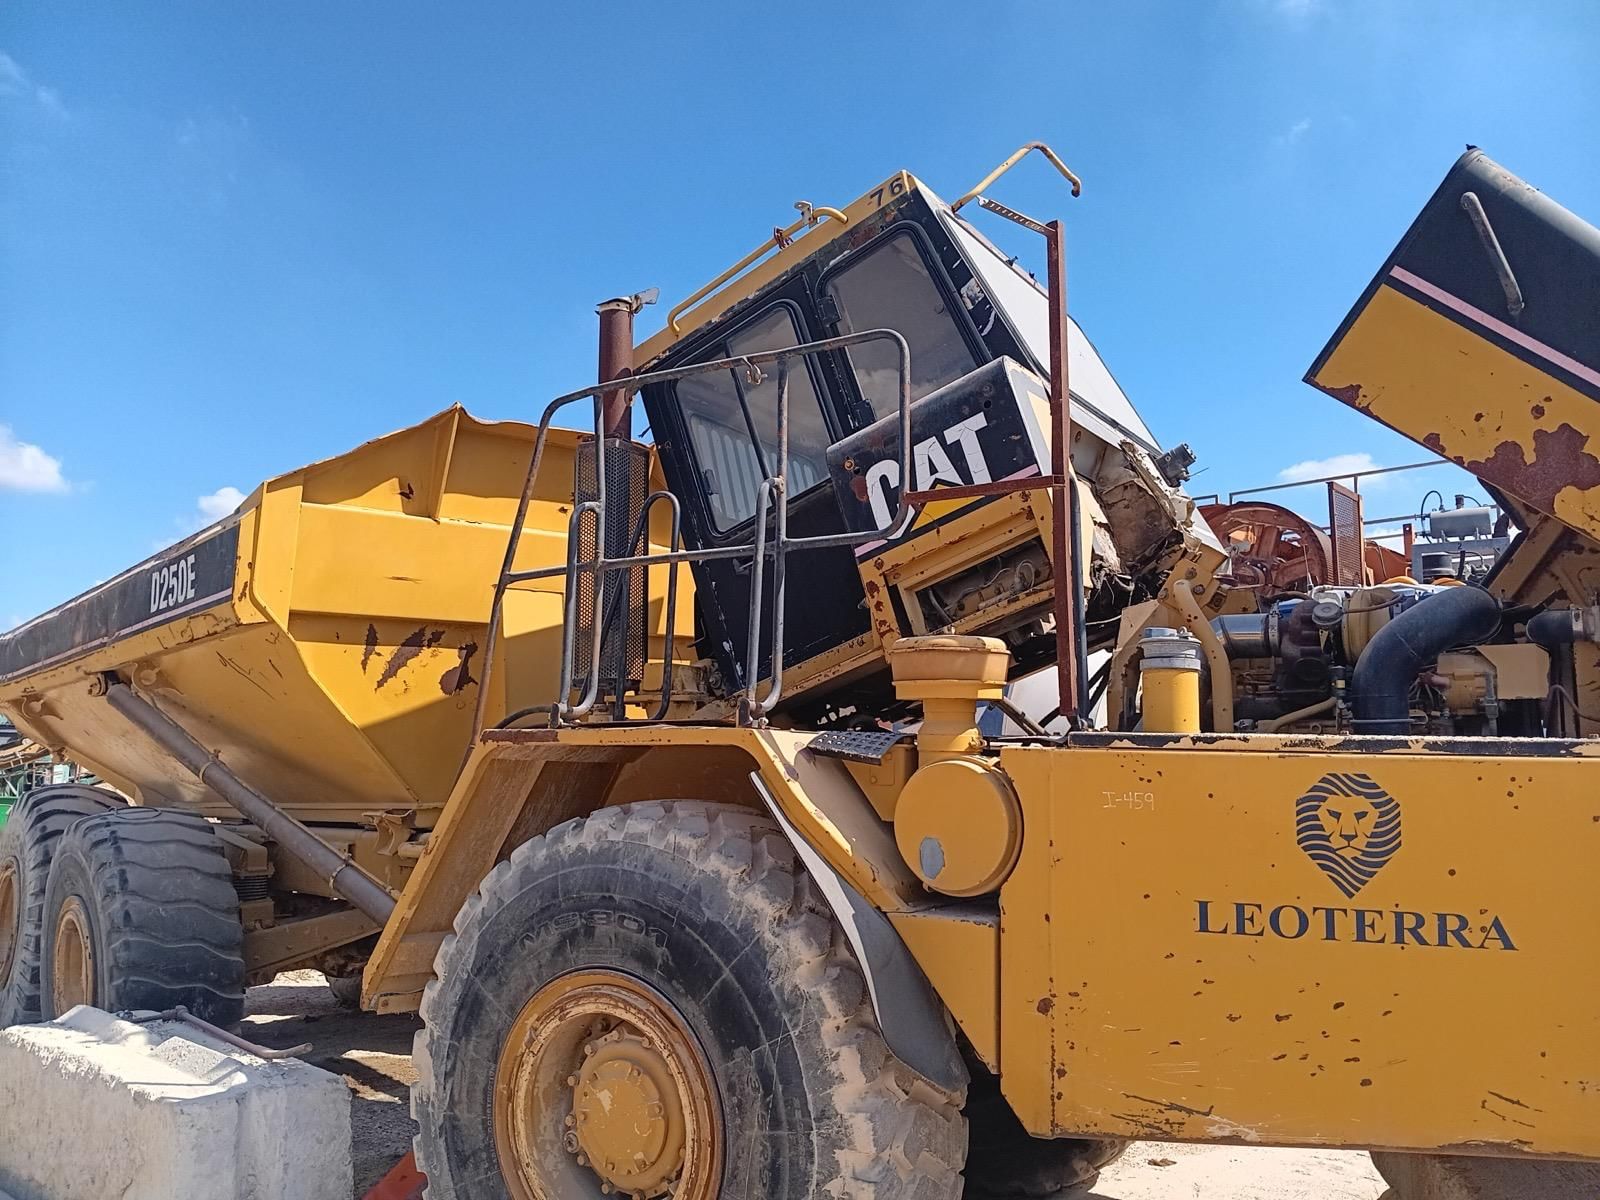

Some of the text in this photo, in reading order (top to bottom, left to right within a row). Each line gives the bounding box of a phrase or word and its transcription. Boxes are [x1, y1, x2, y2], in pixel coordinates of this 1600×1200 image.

[865, 411, 989, 540] CAT
[150, 554, 196, 613] D250E
[1194, 899, 1520, 951] LEOTERRA
